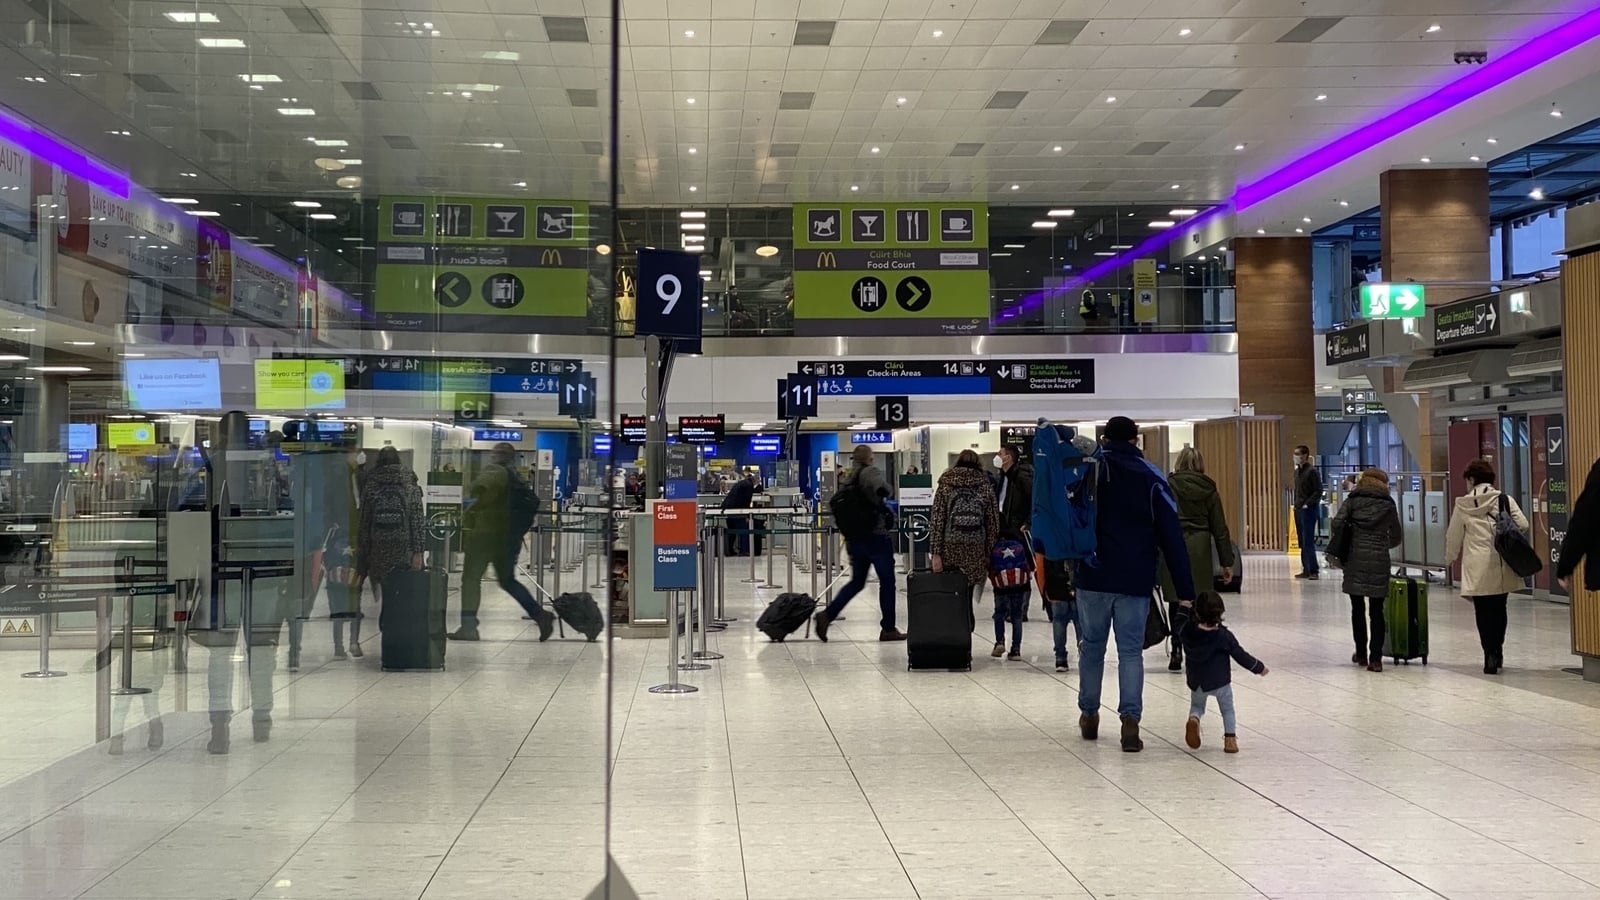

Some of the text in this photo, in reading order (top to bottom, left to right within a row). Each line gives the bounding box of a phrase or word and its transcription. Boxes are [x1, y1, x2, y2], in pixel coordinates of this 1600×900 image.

[866, 261, 916, 269] Food Court
[656, 273, 682, 315] 9
[1437, 324, 1475, 342] Departure Gates
[1359, 333, 1367, 352] 14
[829, 364, 845, 375] 13
[867, 369, 921, 377] Check-in Areas
[943, 363, 958, 375] 14
[792, 385, 812, 405] 11
[880, 404, 904, 421] 13
[657, 512, 678, 520] Class
[657, 547, 690, 555] Business
[657, 555, 678, 563] Class
